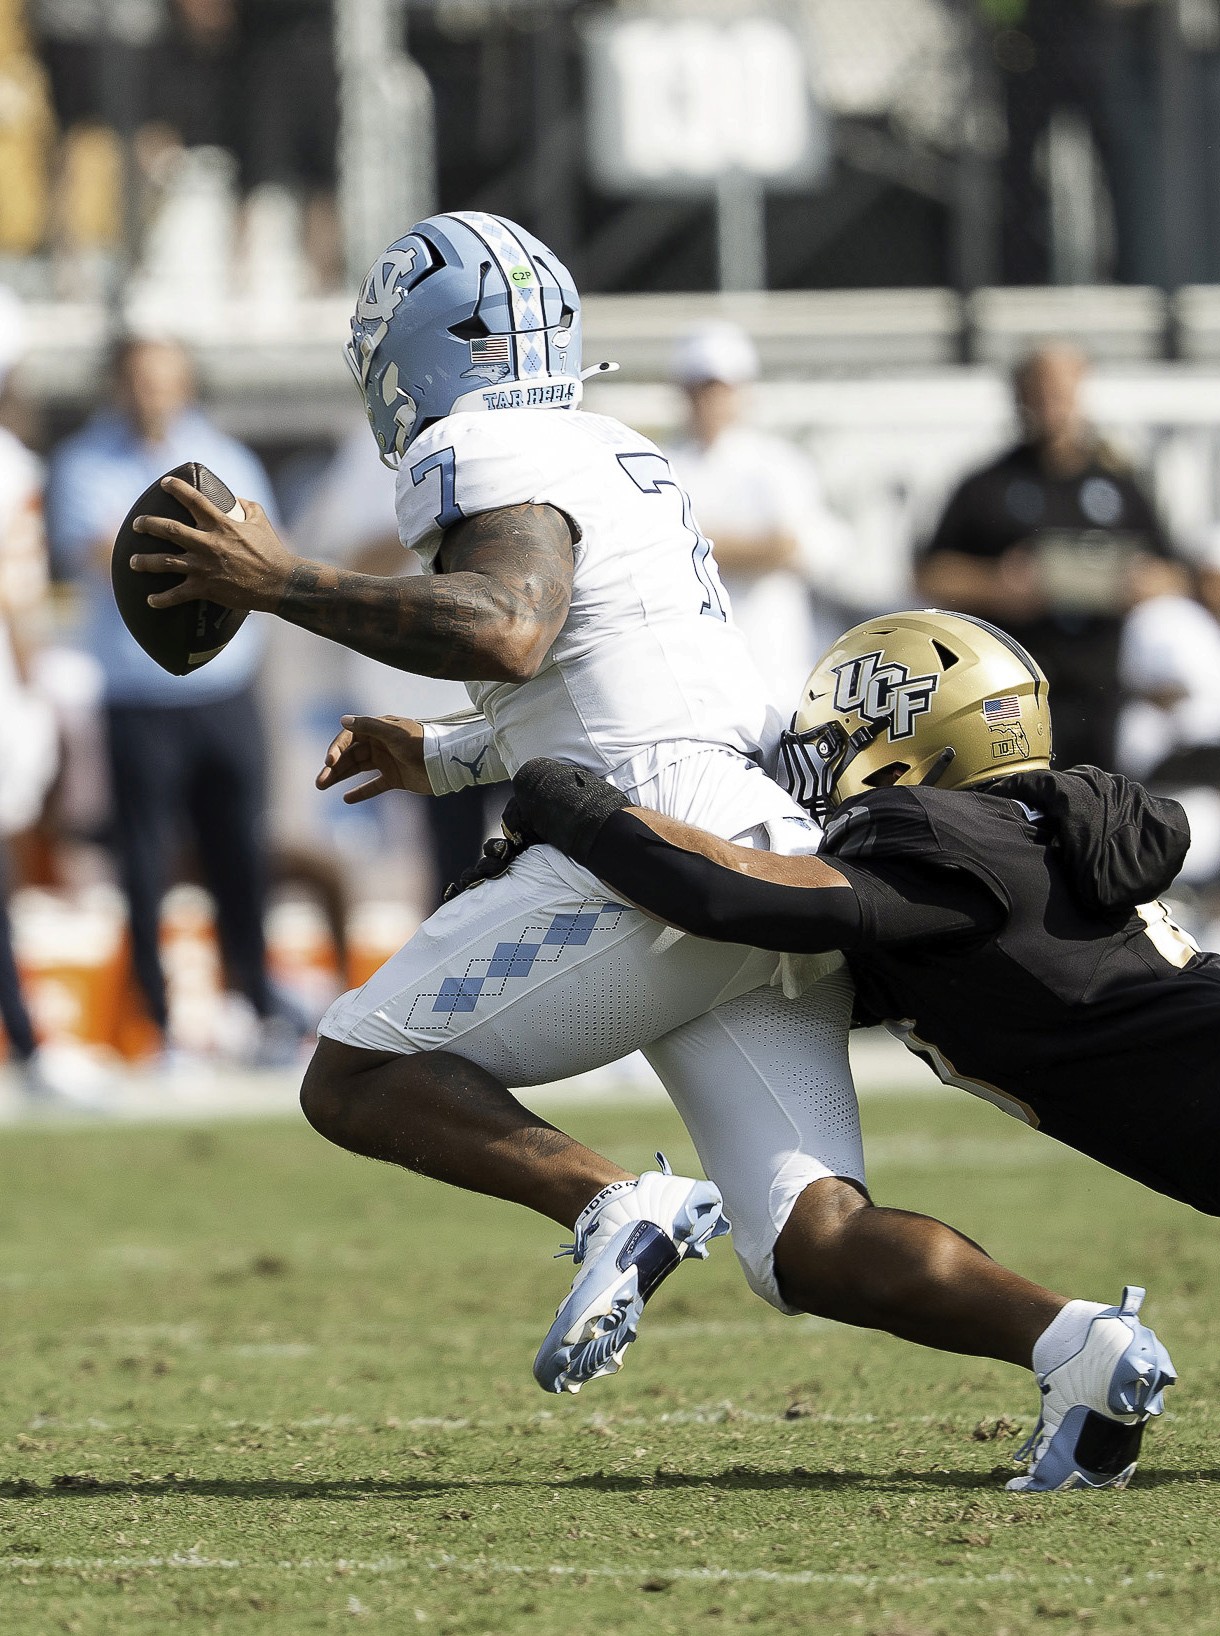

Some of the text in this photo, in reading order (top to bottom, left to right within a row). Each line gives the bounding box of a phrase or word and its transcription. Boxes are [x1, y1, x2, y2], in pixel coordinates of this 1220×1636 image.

[512, 271, 531, 281] C2P
[559, 350, 567, 374] 7
[483, 383, 575, 410] TAR HEELS
[410, 446, 467, 529] 7
[615, 452, 727, 622] 7
[830, 649, 940, 744] UCF
[998, 743, 1009, 755] 10
